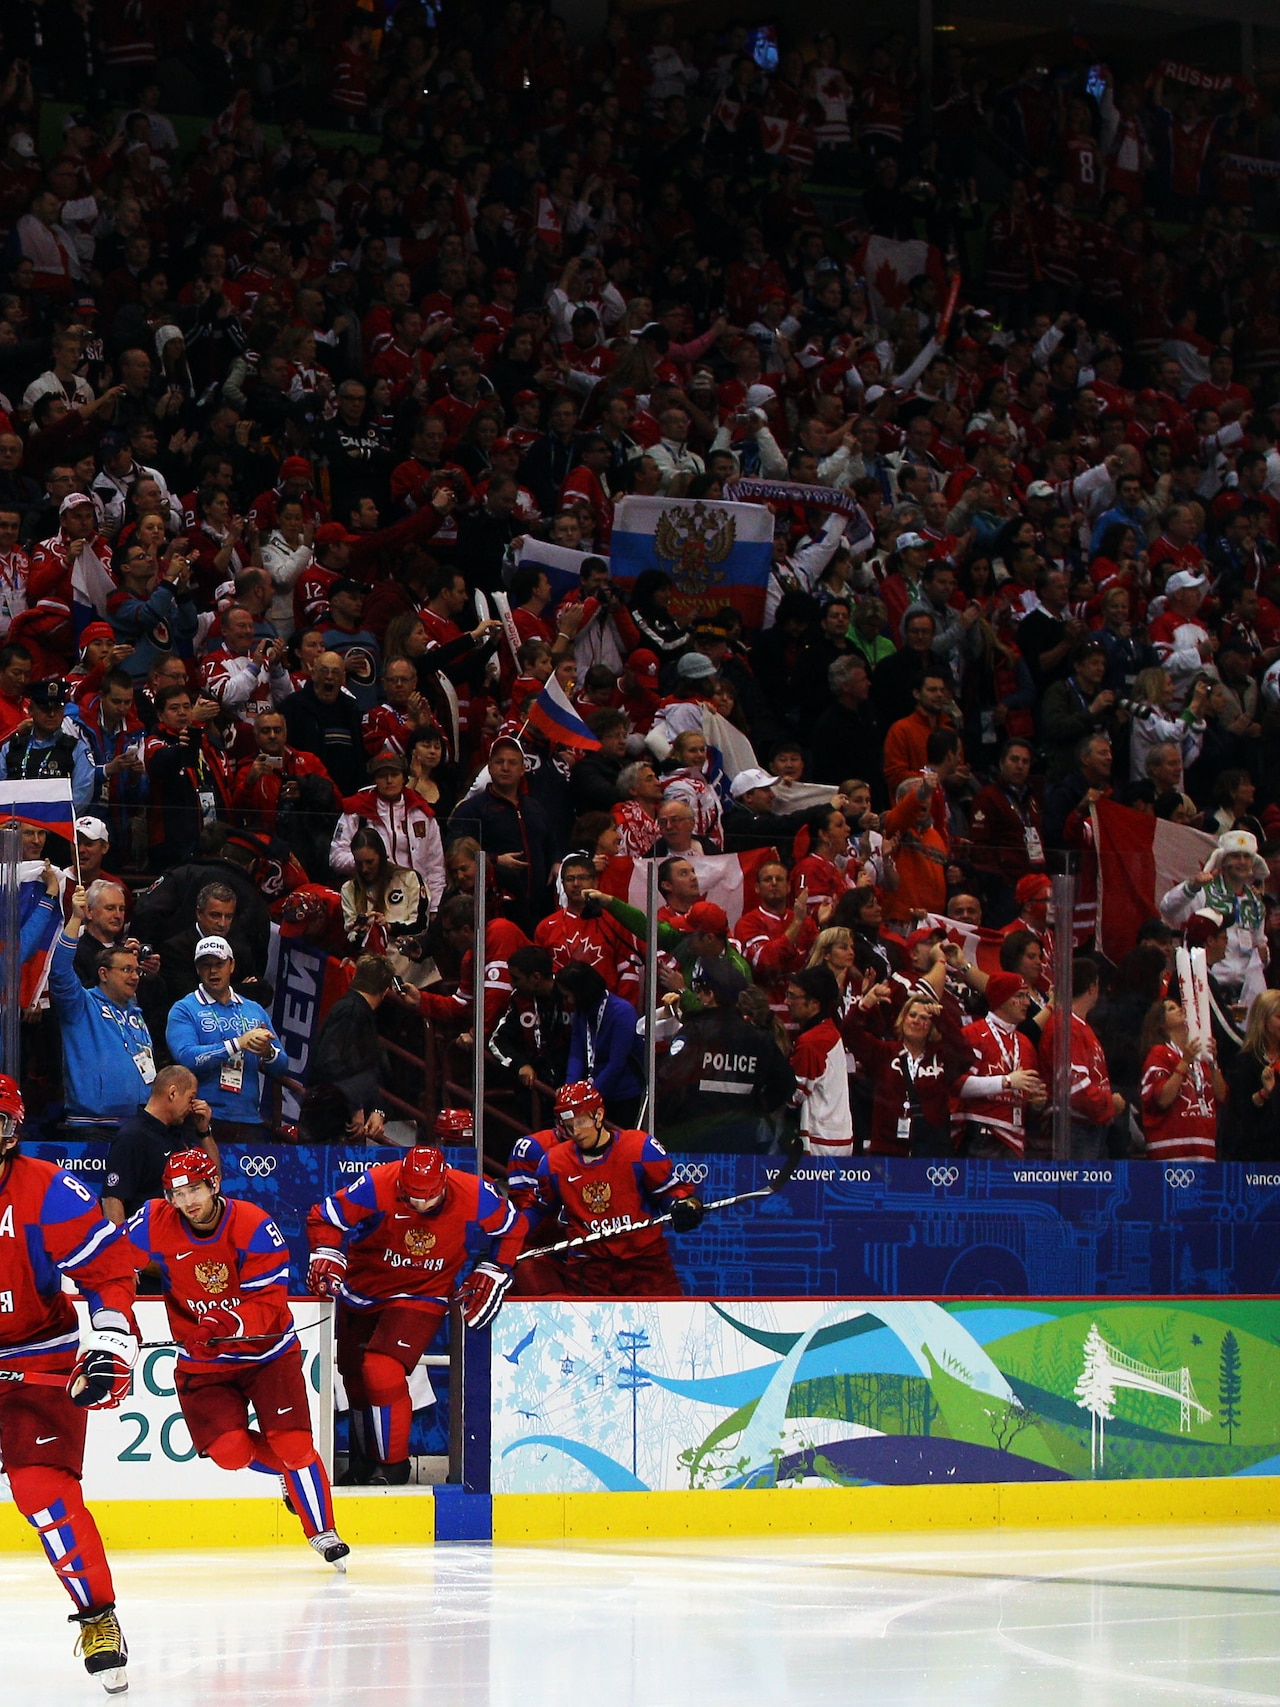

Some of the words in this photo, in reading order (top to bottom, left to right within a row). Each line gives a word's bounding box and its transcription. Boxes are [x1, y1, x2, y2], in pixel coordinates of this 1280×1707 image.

[1164, 61, 1232, 91] RUSSIA
[1079, 150, 1095, 184] 8
[591, 356, 601, 369] A
[185, 510, 196, 528] 2
[304, 582, 323, 599] 12
[199, 943, 225, 951] SOCHI
[702, 1052, 757, 1074] POLICE
[348, 1175, 366, 1193] 6
[766, 1170, 833, 1182] vacouver
[837, 1170, 869, 1182] 2010
[1013, 1170, 1079, 1182] vancouver
[1083, 1170, 1112, 1182] 2010
[62, 1175, 91, 1201] 8
[383, 1248, 445, 1271] РОСИЯ
[98, 1335, 129, 1350] CCM
